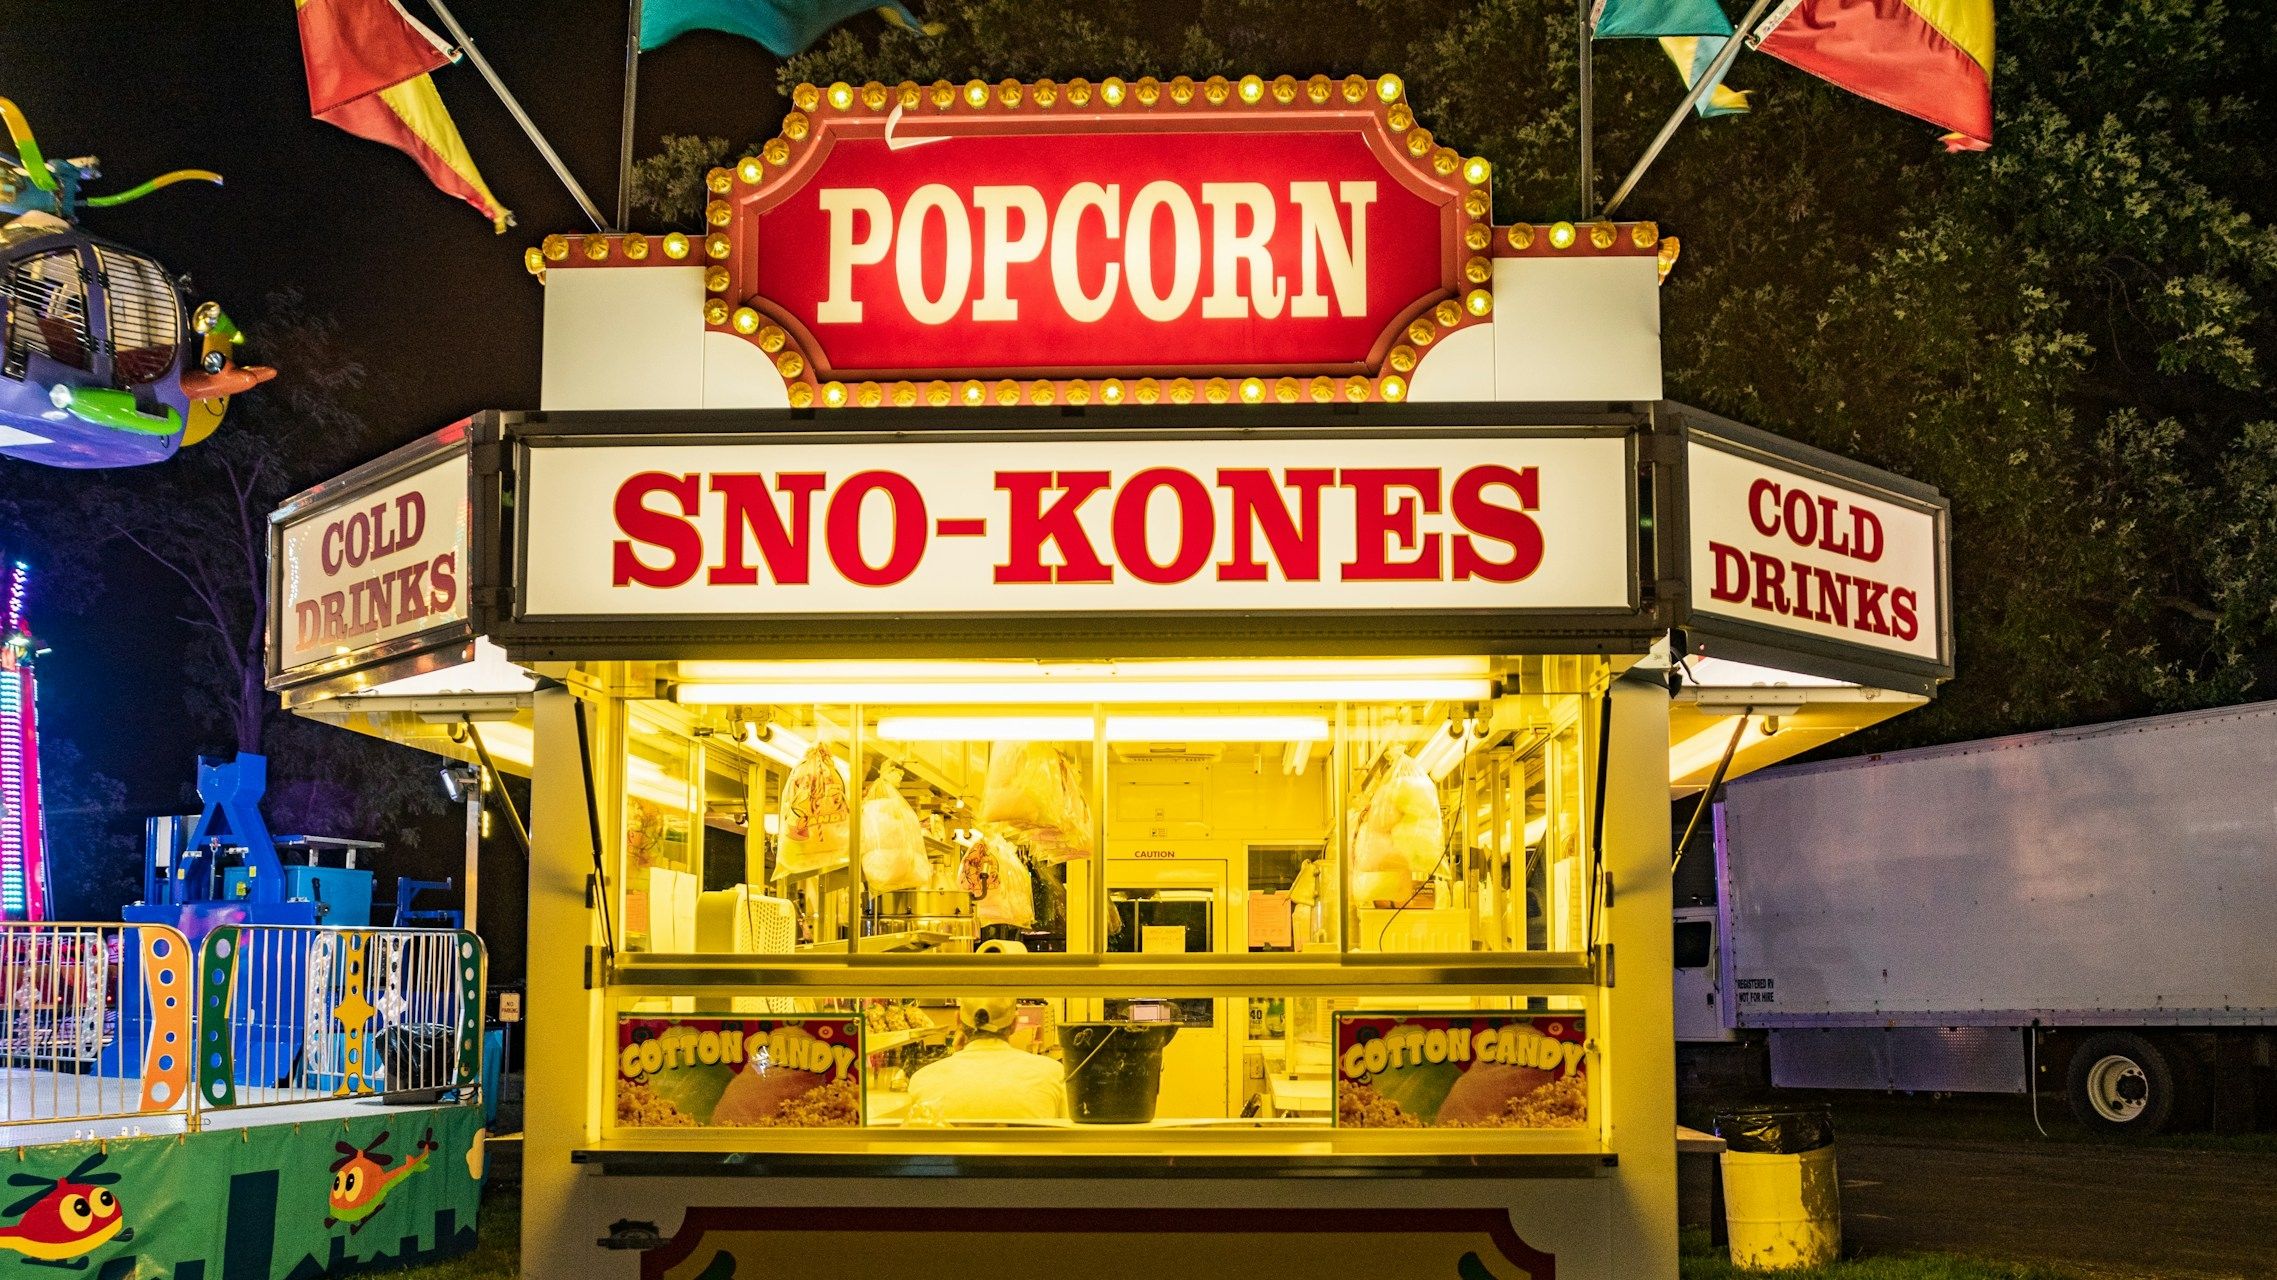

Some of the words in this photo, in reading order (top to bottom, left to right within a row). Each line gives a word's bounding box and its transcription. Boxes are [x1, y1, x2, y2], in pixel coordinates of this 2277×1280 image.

[817, 180, 1377, 325] POPCORN
[321, 490, 426, 577] COLD
[611, 464, 1545, 589] SNO-KONES
[1748, 477, 1884, 564] COLD
[295, 551, 457, 652] DRINKS
[1709, 540, 1919, 642] DRINKS
[1134, 850, 1175, 858] CAUTION
[1249, 1009, 1263, 1020] 40
[1739, 992, 1749, 1002] NOT
[1750, 992, 1761, 1002] FOR
[1761, 992, 1774, 1002] HIRE
[621, 1030, 744, 1078] COTTON
[747, 1031, 856, 1080] CANDY
[1343, 1028, 1472, 1079] COTTON
[1475, 1028, 1586, 1077] CANDY
